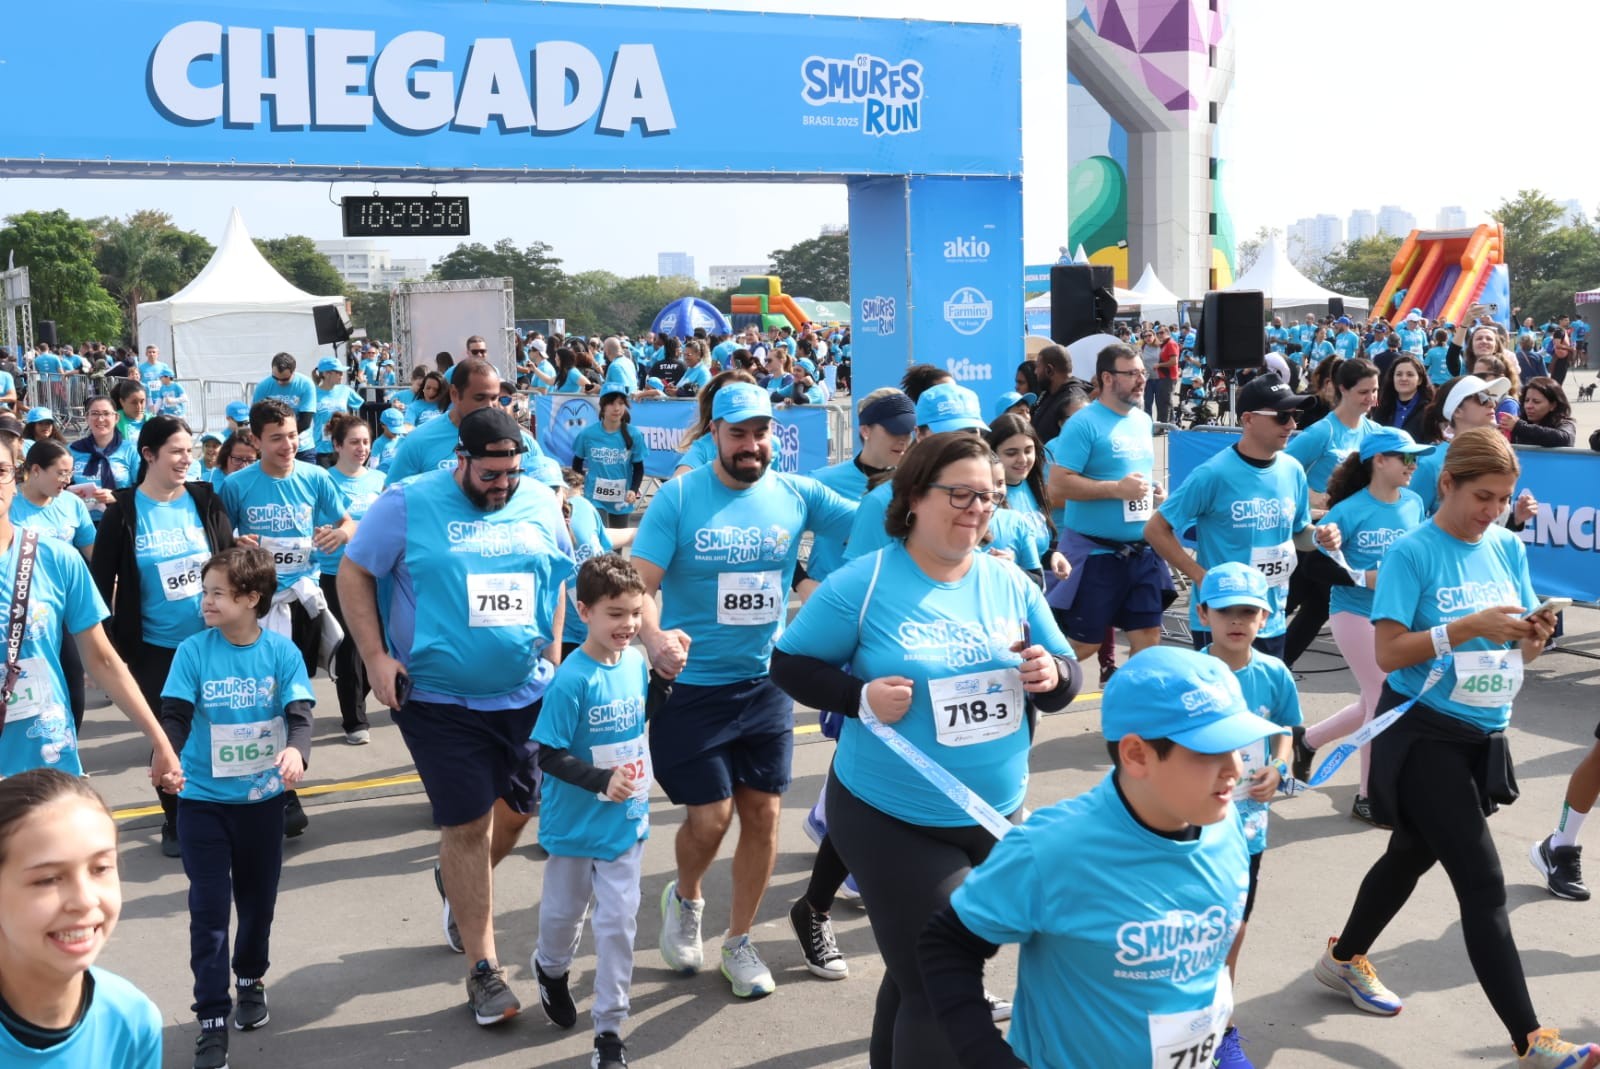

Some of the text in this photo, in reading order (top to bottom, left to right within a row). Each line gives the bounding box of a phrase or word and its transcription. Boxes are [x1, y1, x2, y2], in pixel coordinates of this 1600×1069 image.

[148, 21, 677, 136] CHEGADA
[804, 59, 921, 100] SMURFS
[802, 115, 859, 127] BRASIL 2025
[865, 98, 918, 134] RUN
[361, 201, 463, 228] 10:29:38
[943, 235, 991, 258] akio
[863, 299, 895, 320] SMURFS
[948, 304, 988, 317] Farmina
[878, 317, 894, 335] RUN
[659, 363, 678, 371] STAFF
[946, 358, 992, 381] kim
[248, 505, 295, 522] SMURFS
[1231, 500, 1279, 519] SMURFS
[272, 518, 293, 532] RUN
[1257, 515, 1278, 529] RUN
[696, 527, 761, 550] SMURFS
[728, 547, 759, 563] RUN
[1257, 561, 1290, 576] 735-1
[17, 558, 32, 599] adidas
[477, 594, 523, 611] 718-2
[724, 594, 774, 610] 883-1
[8, 622, 23, 665] didas
[949, 643, 990, 666] RUN
[204, 679, 256, 699] SMURFS
[1462, 674, 1513, 693] 468-1
[231, 694, 255, 708] RUN
[590, 702, 636, 724] SMURFS
[943, 700, 1007, 728] 718-3
[616, 715, 636, 732] RUN
[219, 743, 274, 762] 616-2
[1120, 910, 1225, 961] SMURFS
[1174, 944, 1217, 981] RUN
[1114, 969, 1148, 980] BRASIL
[1169, 1033, 1216, 1069] 718
